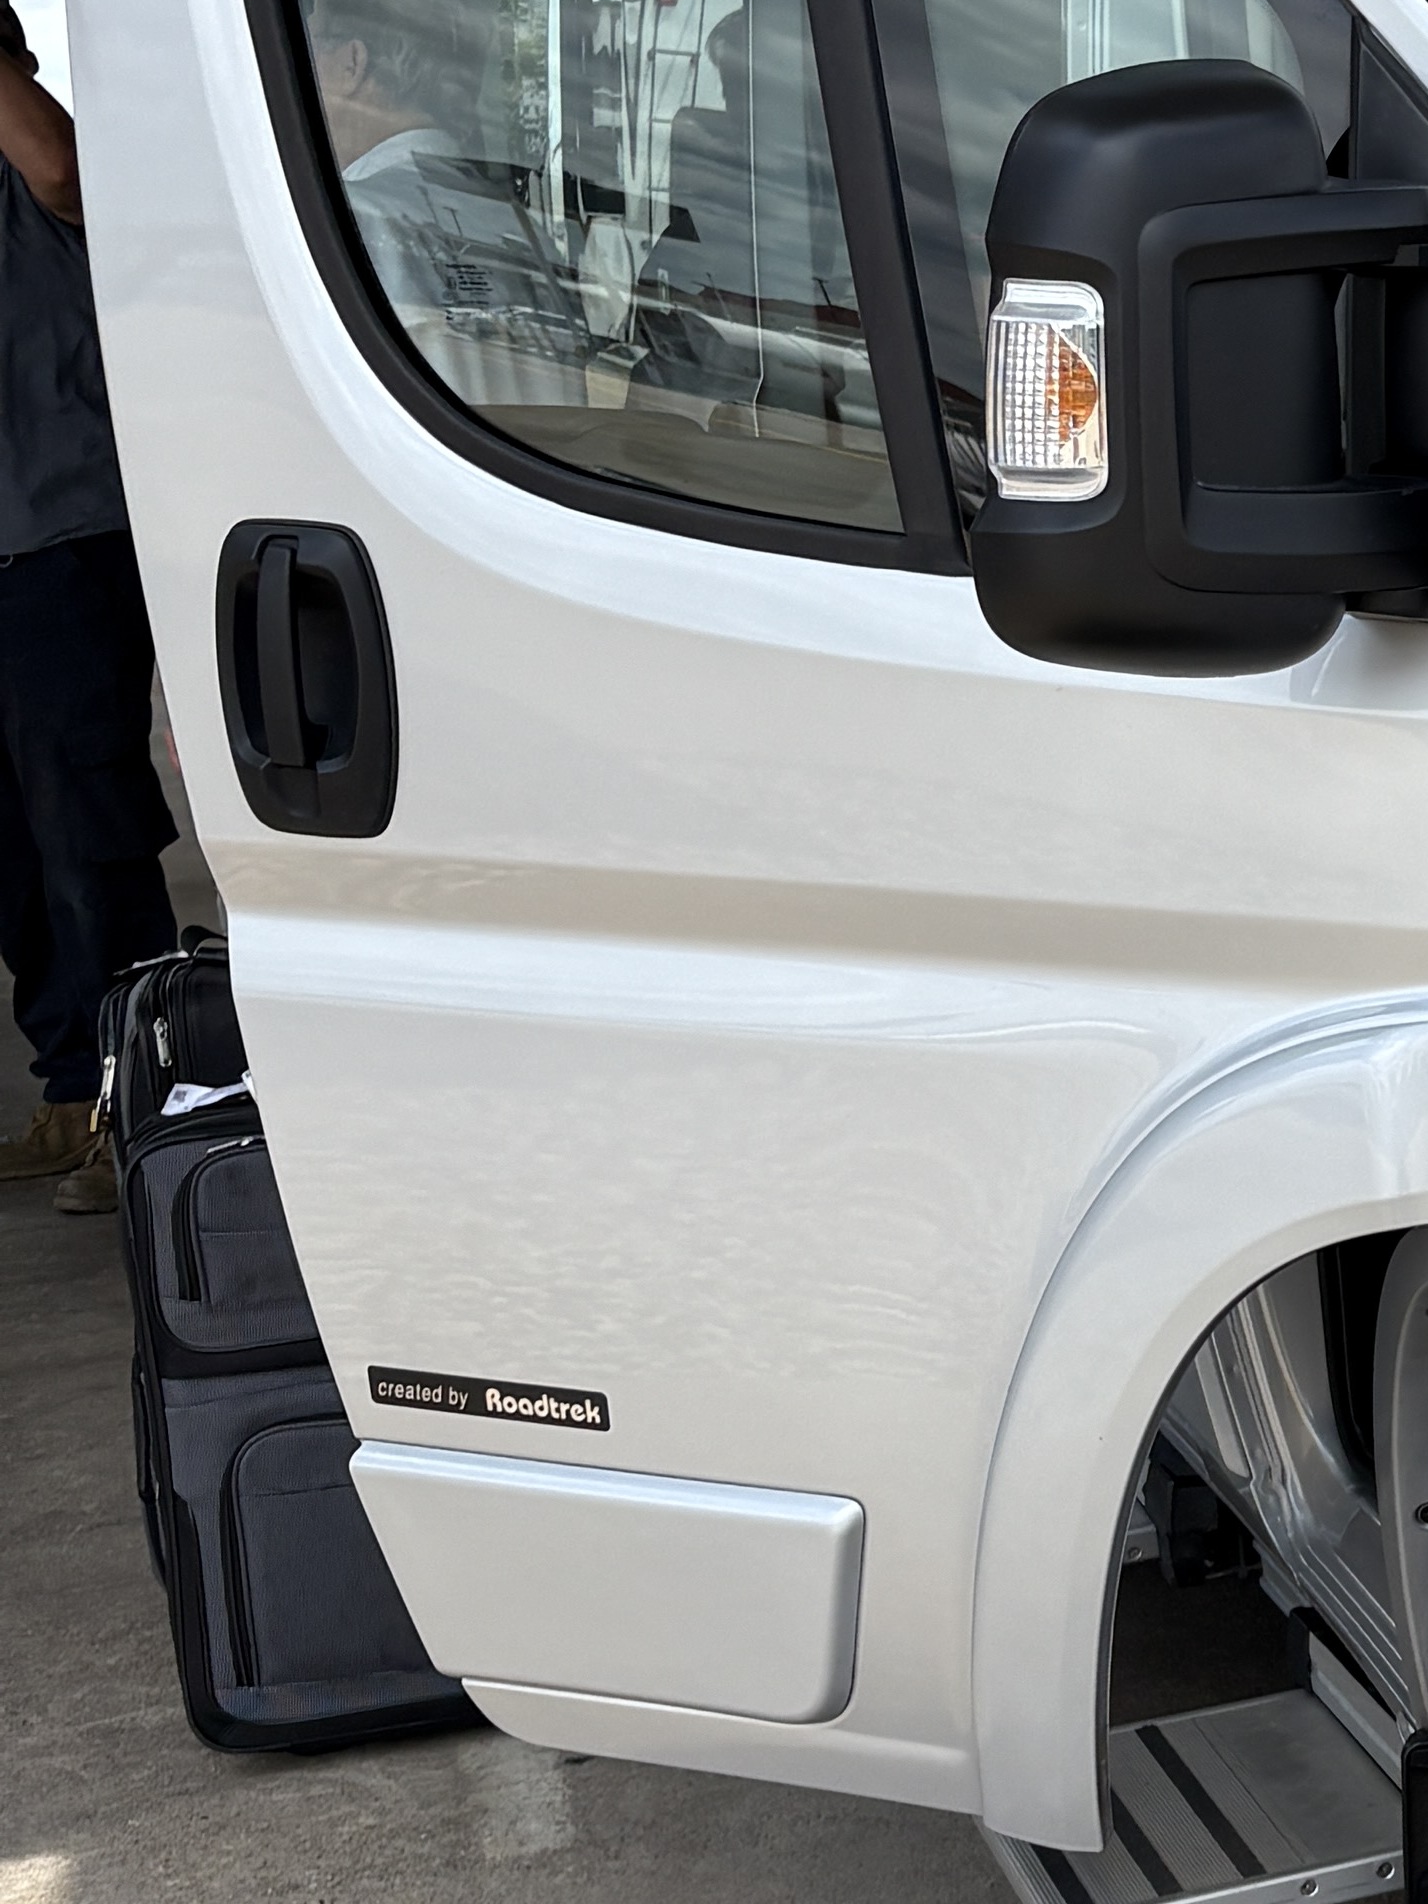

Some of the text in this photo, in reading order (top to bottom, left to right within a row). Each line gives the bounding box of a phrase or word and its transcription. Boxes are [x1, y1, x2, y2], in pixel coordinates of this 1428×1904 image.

[378, 1380, 601, 1425] created by Roadtrek
